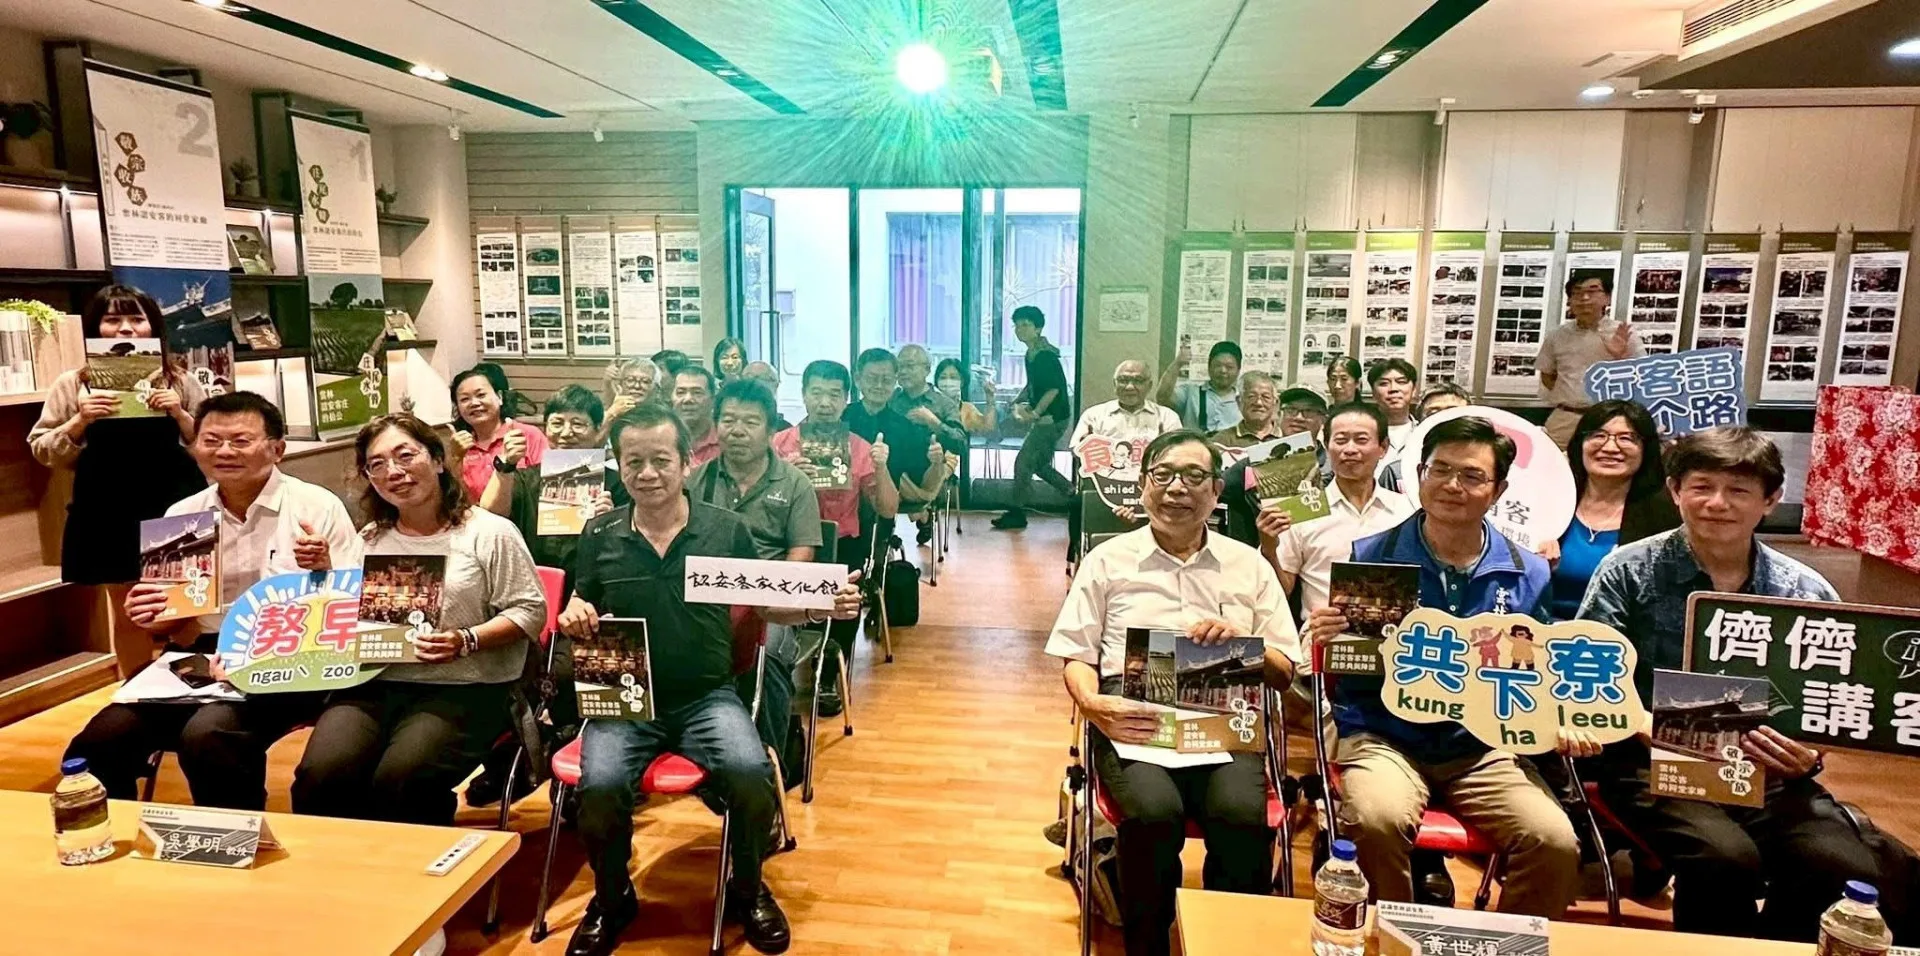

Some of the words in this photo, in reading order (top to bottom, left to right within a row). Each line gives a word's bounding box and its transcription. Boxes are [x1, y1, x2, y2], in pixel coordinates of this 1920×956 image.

[175, 102, 214, 158] 2
[1591, 353, 1735, 402] 行客語
[1397, 688, 1465, 720] kung
[1500, 723, 1537, 745] ha
